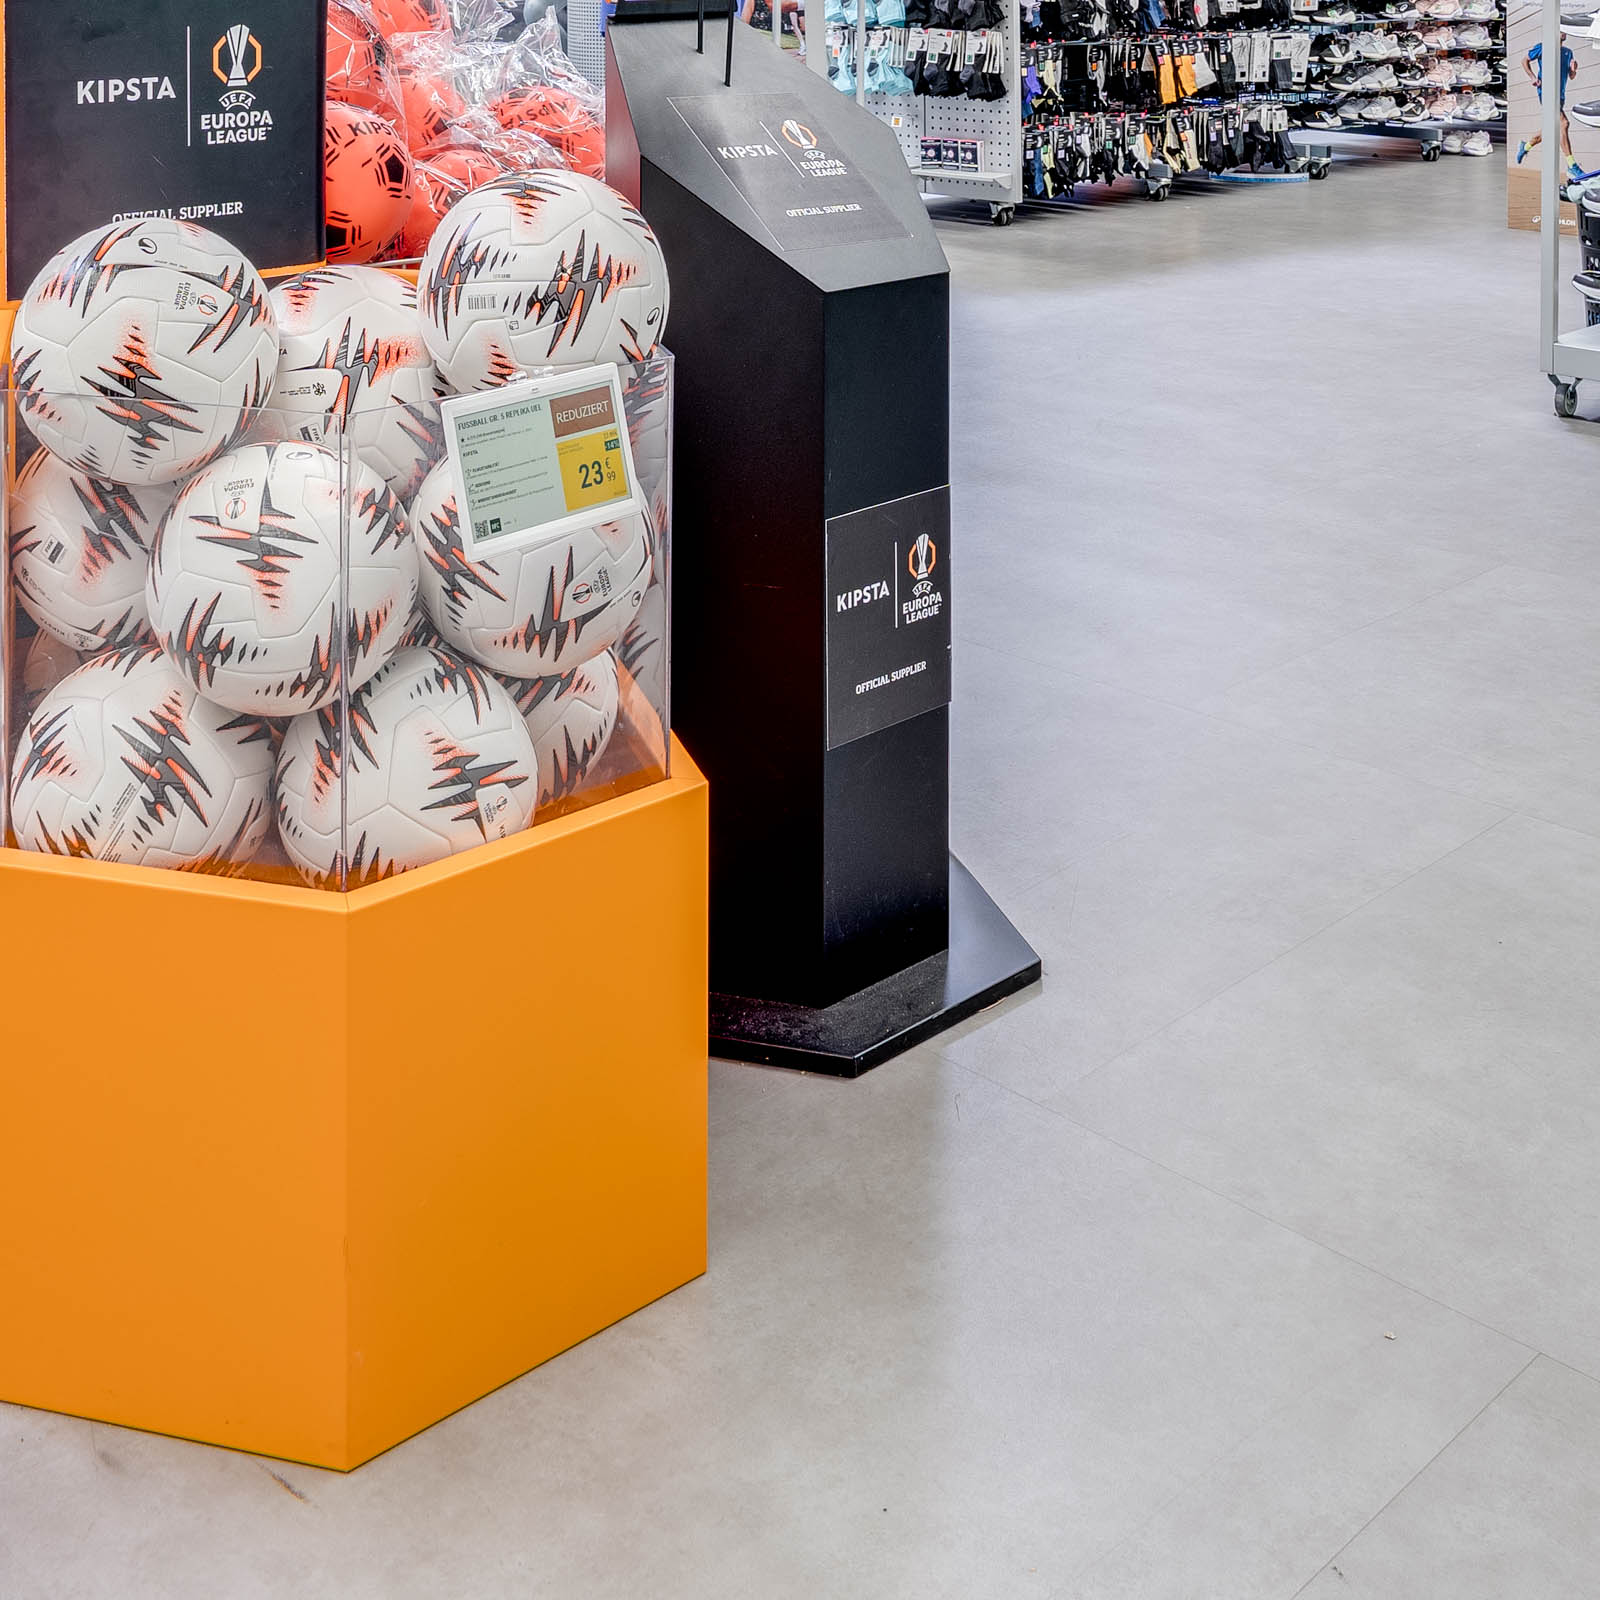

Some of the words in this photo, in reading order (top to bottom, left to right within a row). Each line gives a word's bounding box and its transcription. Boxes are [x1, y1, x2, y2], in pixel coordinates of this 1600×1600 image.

[77, 76, 176, 104] KIPSTA
[220, 92, 254, 108] UEFA
[201, 110, 273, 130] EUROPA
[717, 144, 778, 159] KIPSTA
[800, 159, 845, 170] EUROPA
[179, 201, 243, 220] SUPPLIER
[786, 206, 824, 218] OFFICIAL
[824, 203, 863, 214] SUPPLIER
[180, 282, 191, 310] EUROPA
[457, 417, 488, 431] FUSSBALL
[505, 407, 530, 419] REPLIKA
[556, 401, 610, 424] REDUZIERT
[578, 460, 604, 489] 23
[605, 457, 611, 469] €
[607, 472, 616, 481] 99
[837, 580, 890, 613] KIPSTA
[912, 583, 933, 596] UEFA
[902, 592, 942, 615] EUROPA
[855, 674, 890, 695] OFFICIAL
[891, 660, 927, 682] SUPPLIER
